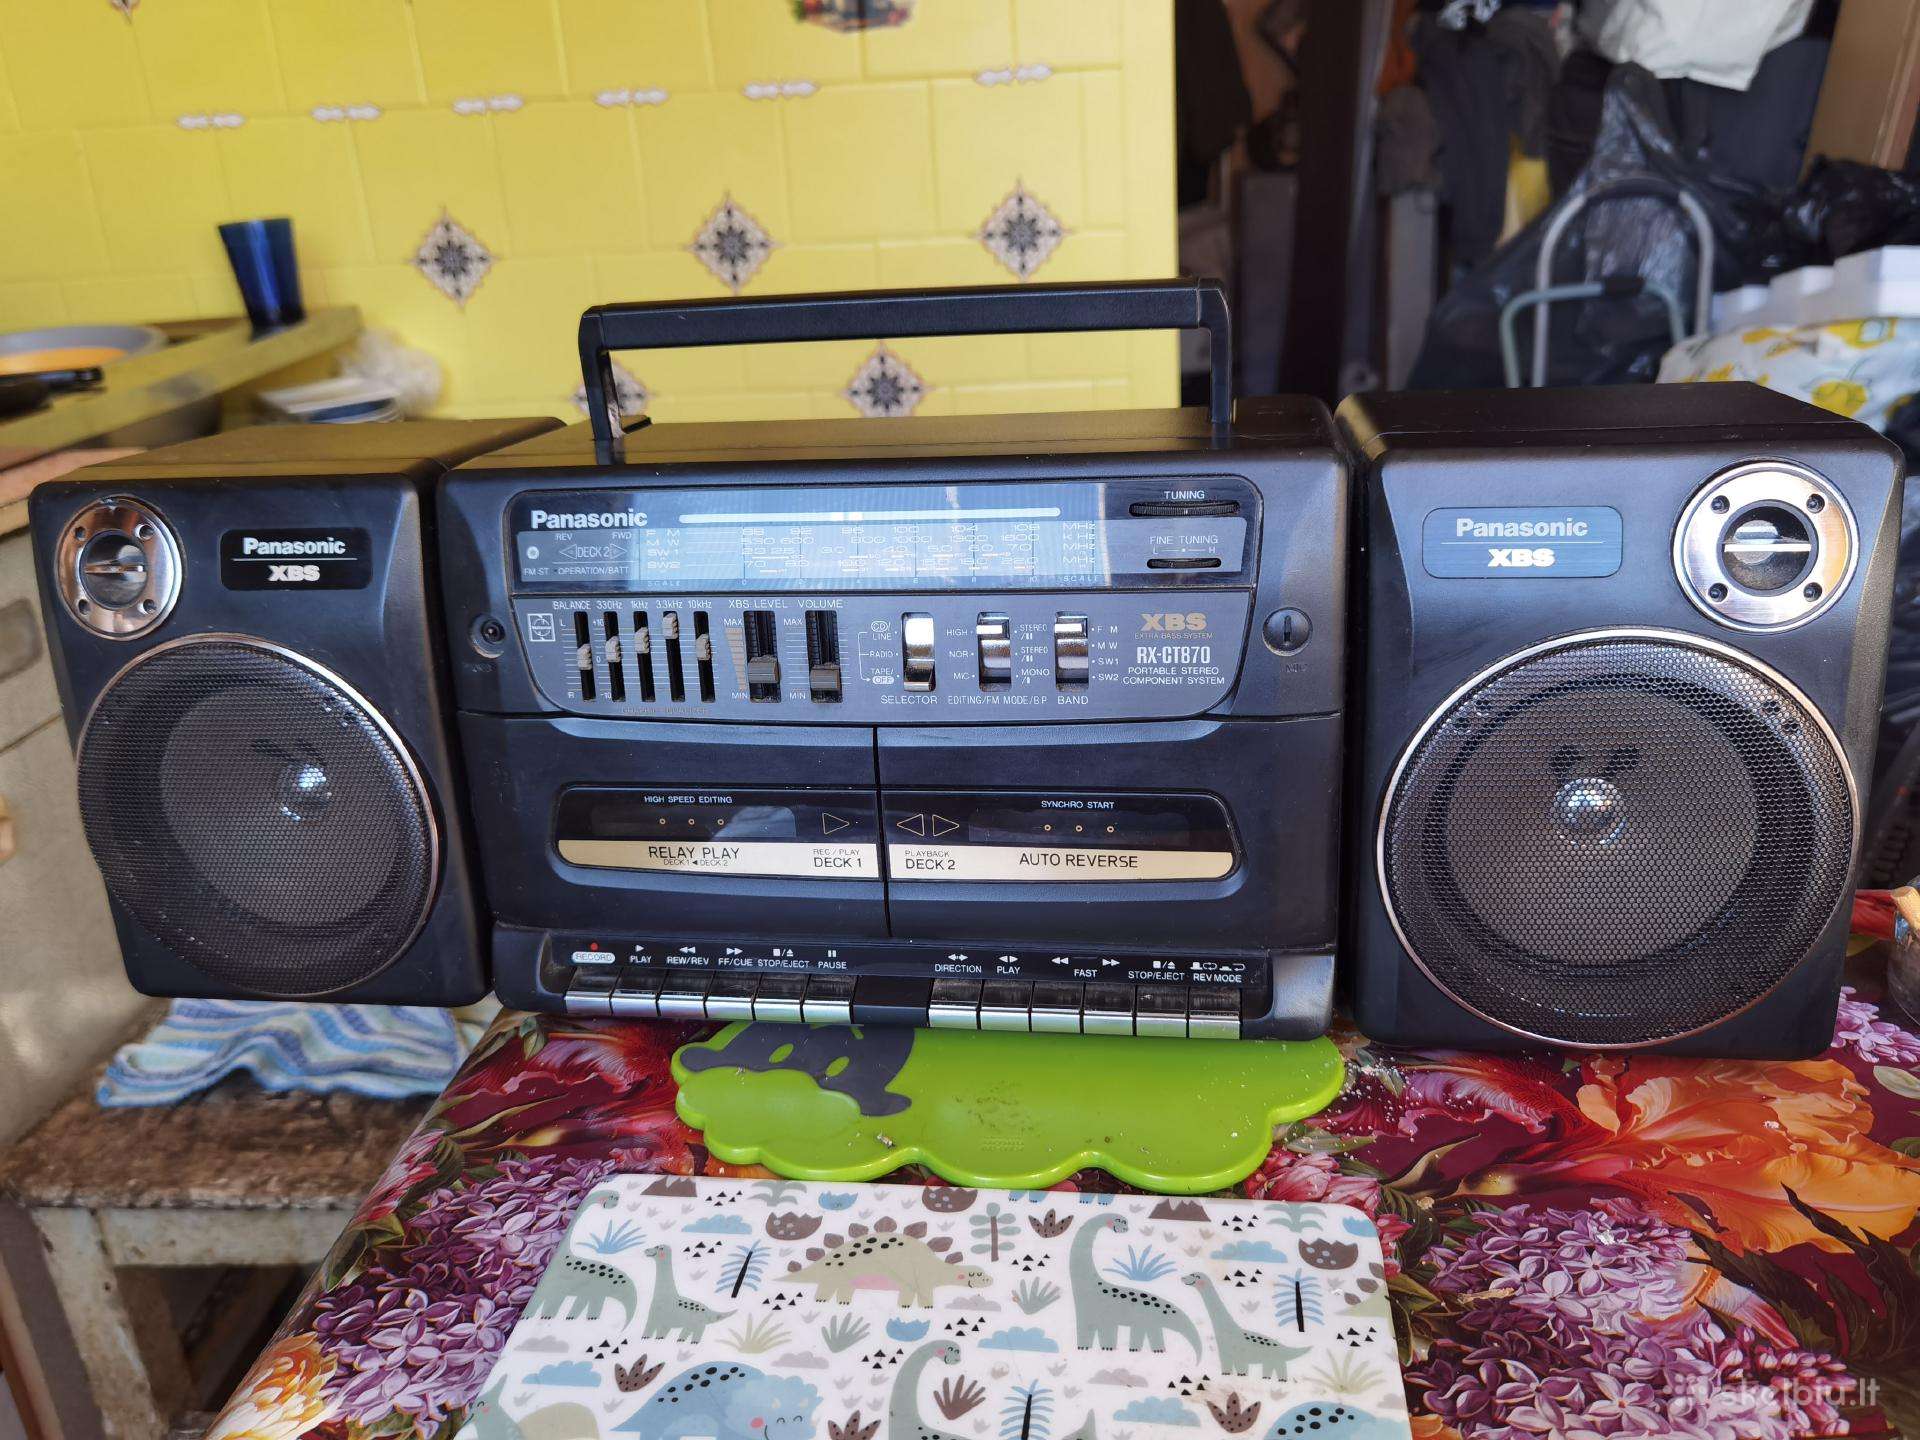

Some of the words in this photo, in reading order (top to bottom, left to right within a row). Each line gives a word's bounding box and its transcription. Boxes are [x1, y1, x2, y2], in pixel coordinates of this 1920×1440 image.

[1164, 491, 1205, 500] TUNING
[531, 509, 648, 529] Panasonic
[893, 525, 920, 534] 100
[1456, 518, 1588, 537] Panasonic
[556, 533, 573, 541] REV
[612, 532, 632, 540] FWD
[1150, 536, 1173, 545] FINE
[1179, 535, 1218, 544] TUNING
[781, 537, 814, 545] 600
[243, 537, 346, 555] Panasonic
[577, 546, 601, 558] DECK
[603, 546, 610, 557] 2
[1487, 548, 1556, 567] XBS
[267, 564, 321, 582] XBS
[558, 566, 629, 575] OPERATION/BATT
[553, 601, 591, 610] BALANCE
[596, 601, 623, 610] 330Hz
[631, 601, 648, 609] 1kHz
[656, 600, 683, 609] 3.3kHz
[688, 600, 712, 609] 10kHz
[729, 600, 749, 608] XBS
[754, 599, 788, 609] LEVEL
[798, 600, 843, 609] VOLUME
[724, 618, 742, 626] MAX
[784, 618, 803, 626] MAX
[1140, 613, 1207, 631] XBS
[1136, 647, 1211, 664] RX-CT870
[871, 668, 893, 676] TAPE/
[1128, 667, 1177, 675] PORTABLE
[1181, 667, 1219, 675] STEREO
[1123, 676, 1183, 685] COMPONENT
[1187, 676, 1225, 685] SYSTEM
[880, 696, 938, 704] SELECTOR
[1057, 696, 1088, 704] BAND
[644, 796, 665, 804] HIGH
[668, 796, 695, 804] SPEED
[699, 796, 732, 804] EDITING
[1041, 800, 1084, 809] SYNCHRO
[1087, 801, 1114, 809] START
[648, 846, 695, 859] RELAY
[702, 847, 740, 859] PLAY
[813, 857, 848, 869] DECK
[905, 859, 944, 870] DECK
[947, 860, 956, 870] 2
[1019, 853, 1060, 867] AUTO
[1065, 853, 1138, 868] REVERSE
[575, 953, 612, 961] RECORD
[630, 955, 652, 964] PLAY
[666, 956, 709, 965] REW/REV
[718, 958, 752, 966] FF/CUE
[757, 959, 809, 968] STOP/EJECT
[817, 961, 847, 969] PAUSE
[934, 963, 982, 973] DIRECTION
[996, 966, 1020, 975] PLAY
[1074, 969, 1098, 978] FAST
[1128, 970, 1185, 981] STOP/EJECT
[1193, 973, 1213, 982] REV
[1215, 974, 1242, 983] MODE
